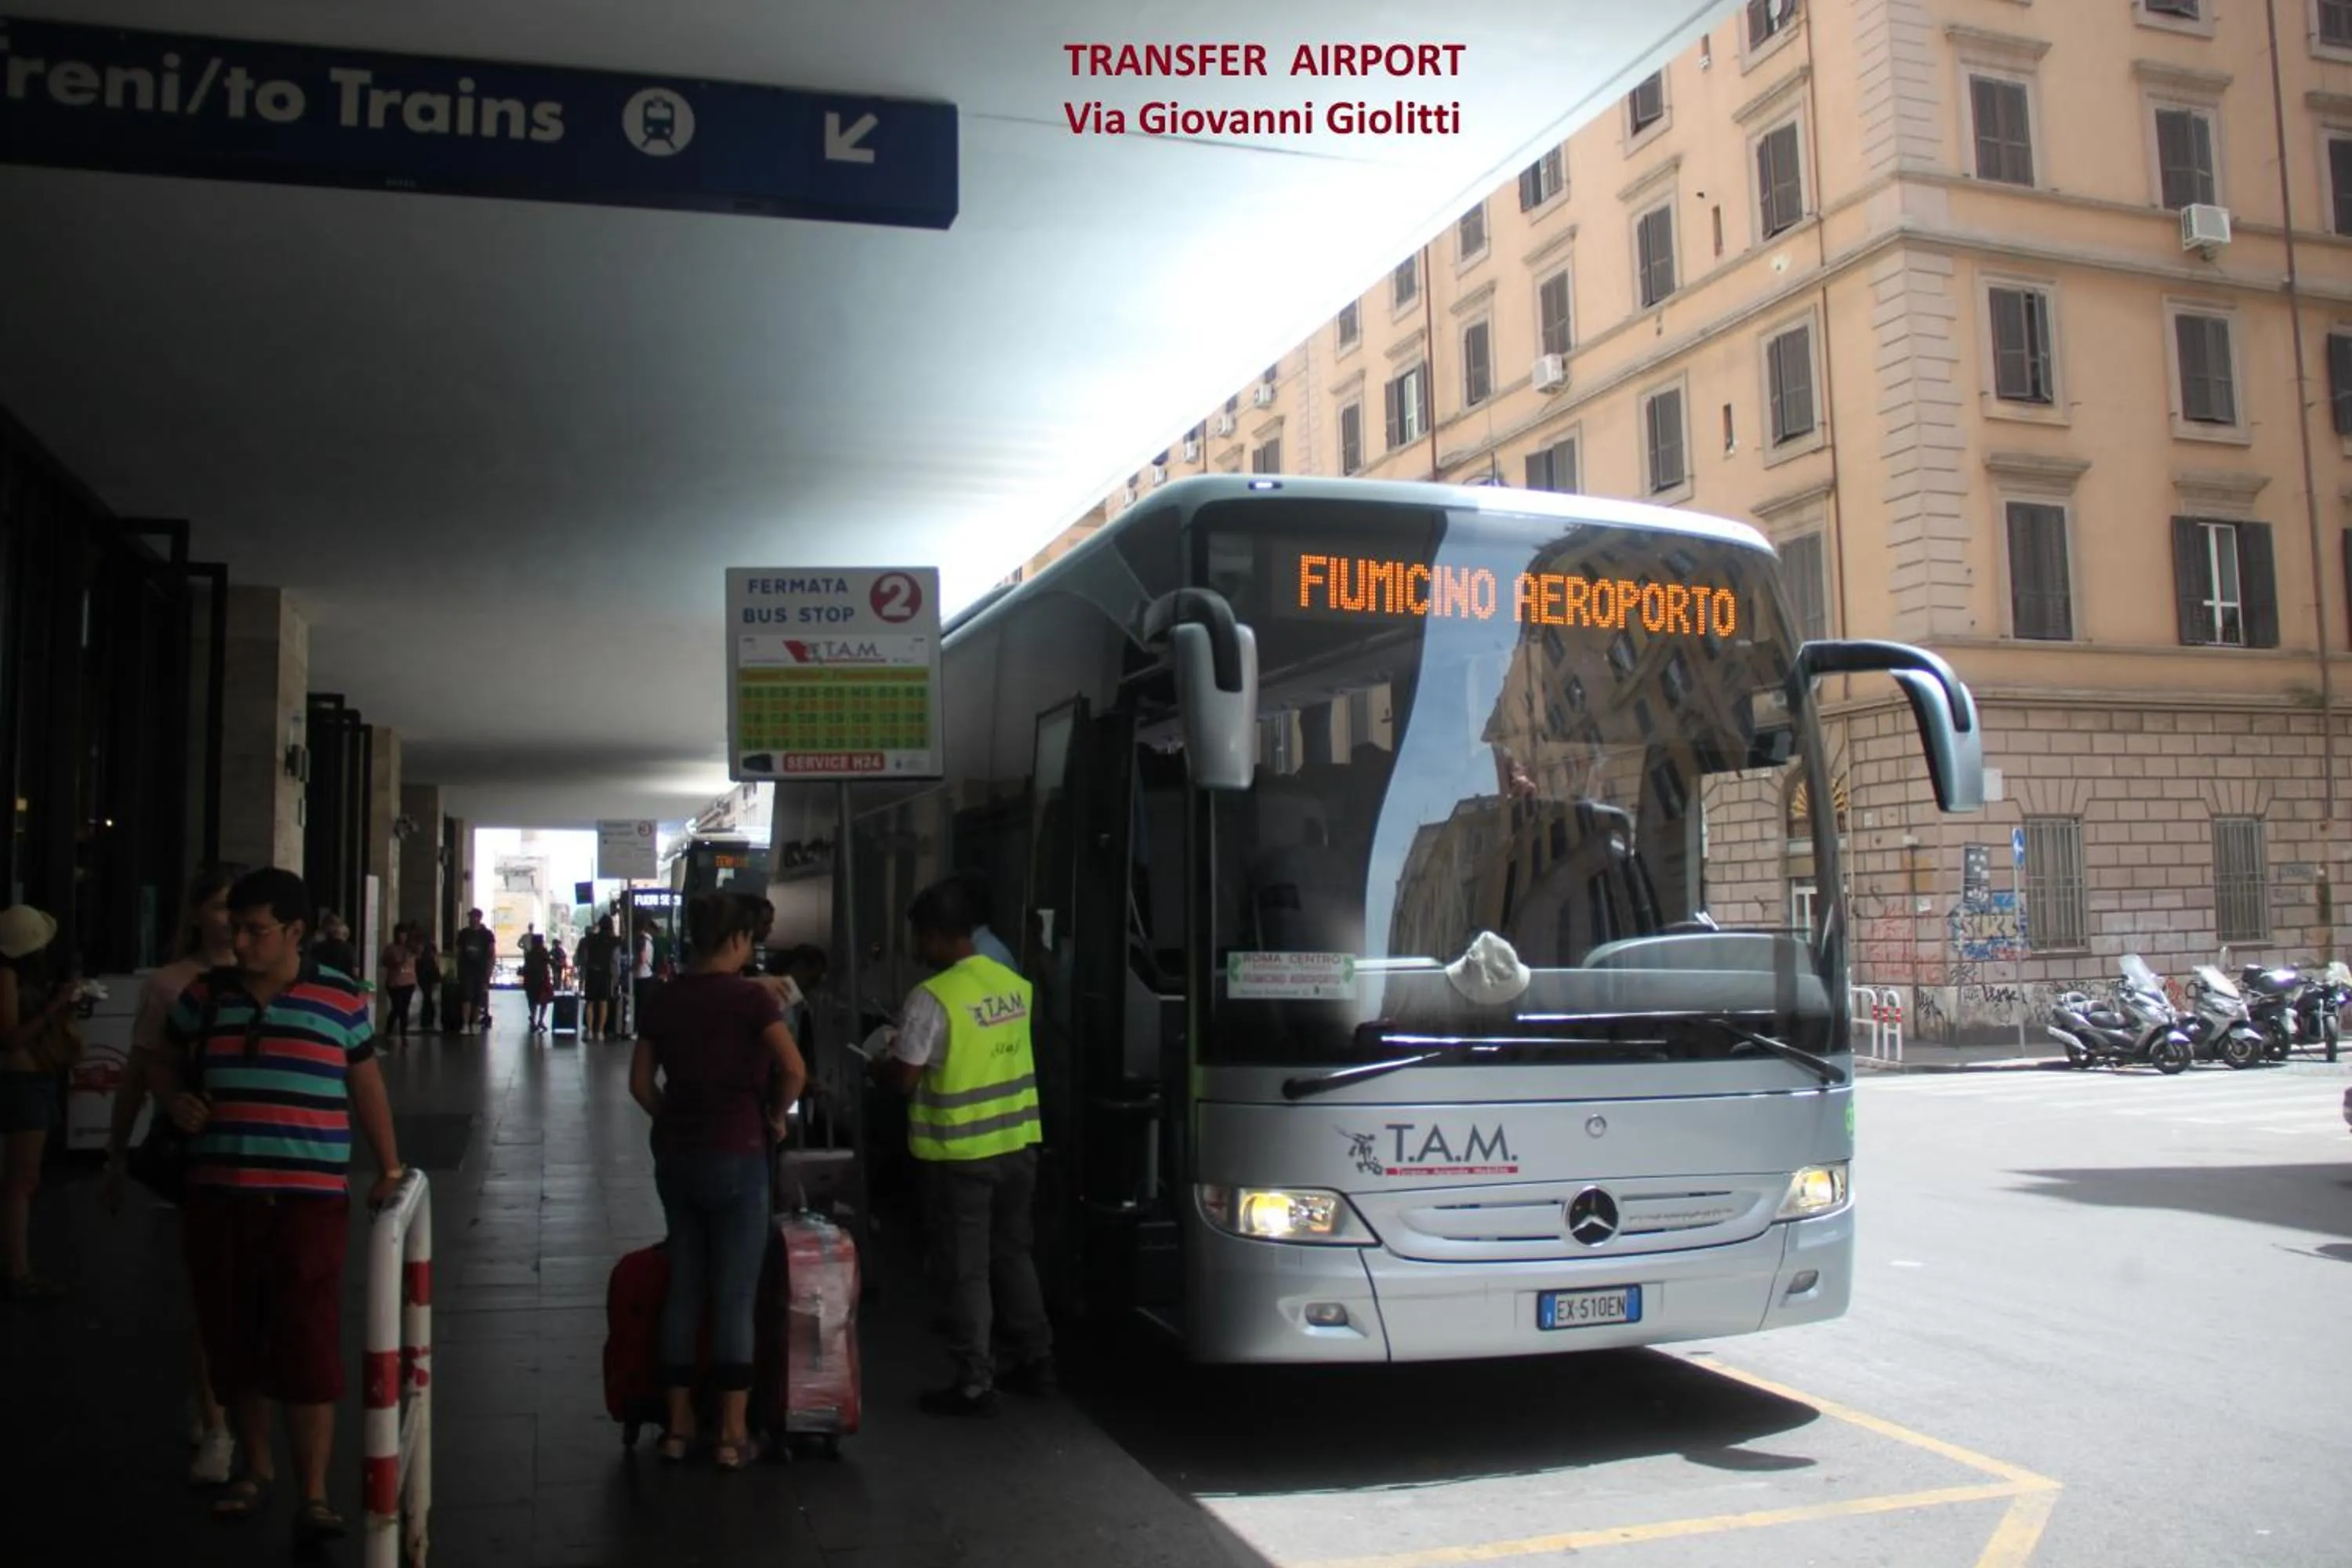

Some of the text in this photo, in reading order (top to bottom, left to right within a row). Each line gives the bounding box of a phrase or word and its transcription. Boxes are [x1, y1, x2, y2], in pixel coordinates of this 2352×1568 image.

[0, 34, 565, 143] reni/to Trains
[742, 606, 855, 624] BUS STOP
[747, 575, 912, 617] FERMATA 2
[1300, 554, 1735, 637] FIUMICINO AEROPORTO
[786, 754, 882, 770] SERVICE H24
[1243, 953, 1341, 964] ROMA CENTRO
[1385, 1123, 1519, 1163] T.A.M.
